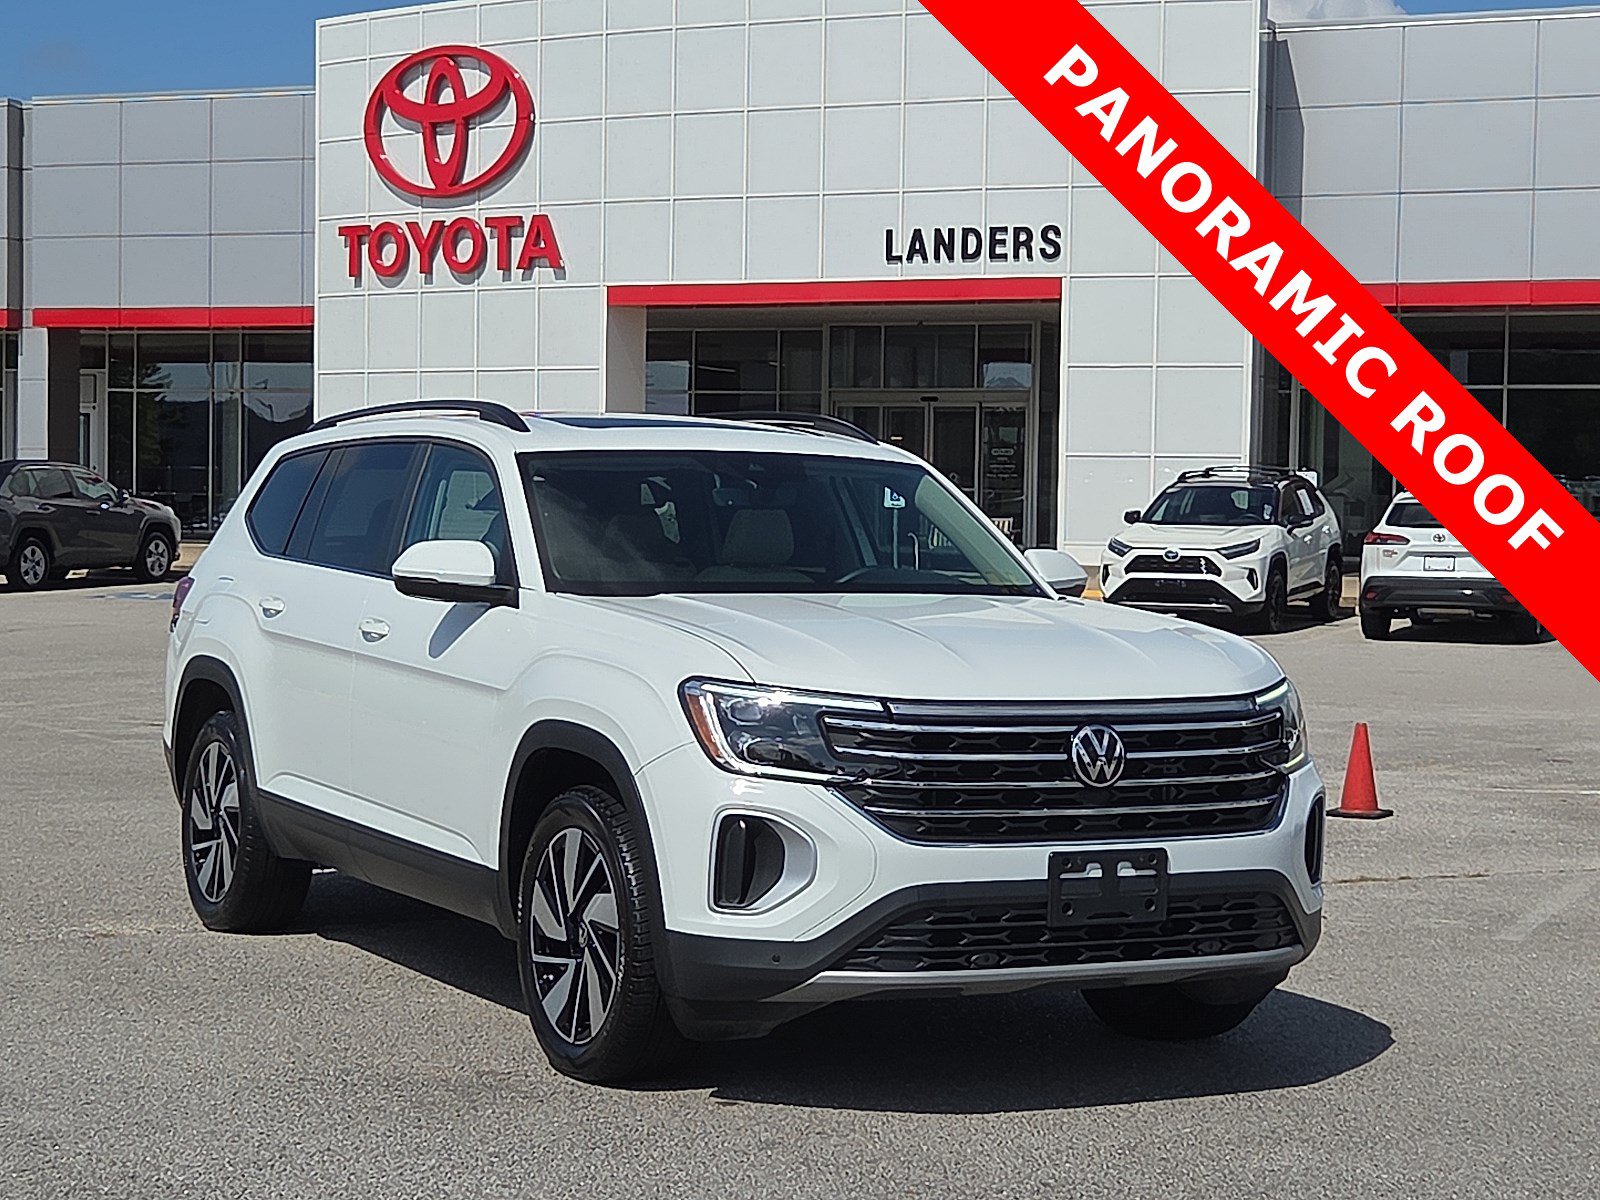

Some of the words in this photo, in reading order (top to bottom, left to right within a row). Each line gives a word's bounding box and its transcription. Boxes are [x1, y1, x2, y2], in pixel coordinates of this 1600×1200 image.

[338, 214, 564, 279] TOYOTA
[885, 225, 1062, 264] LANDERS
[1072, 725, 1125, 786] VW
